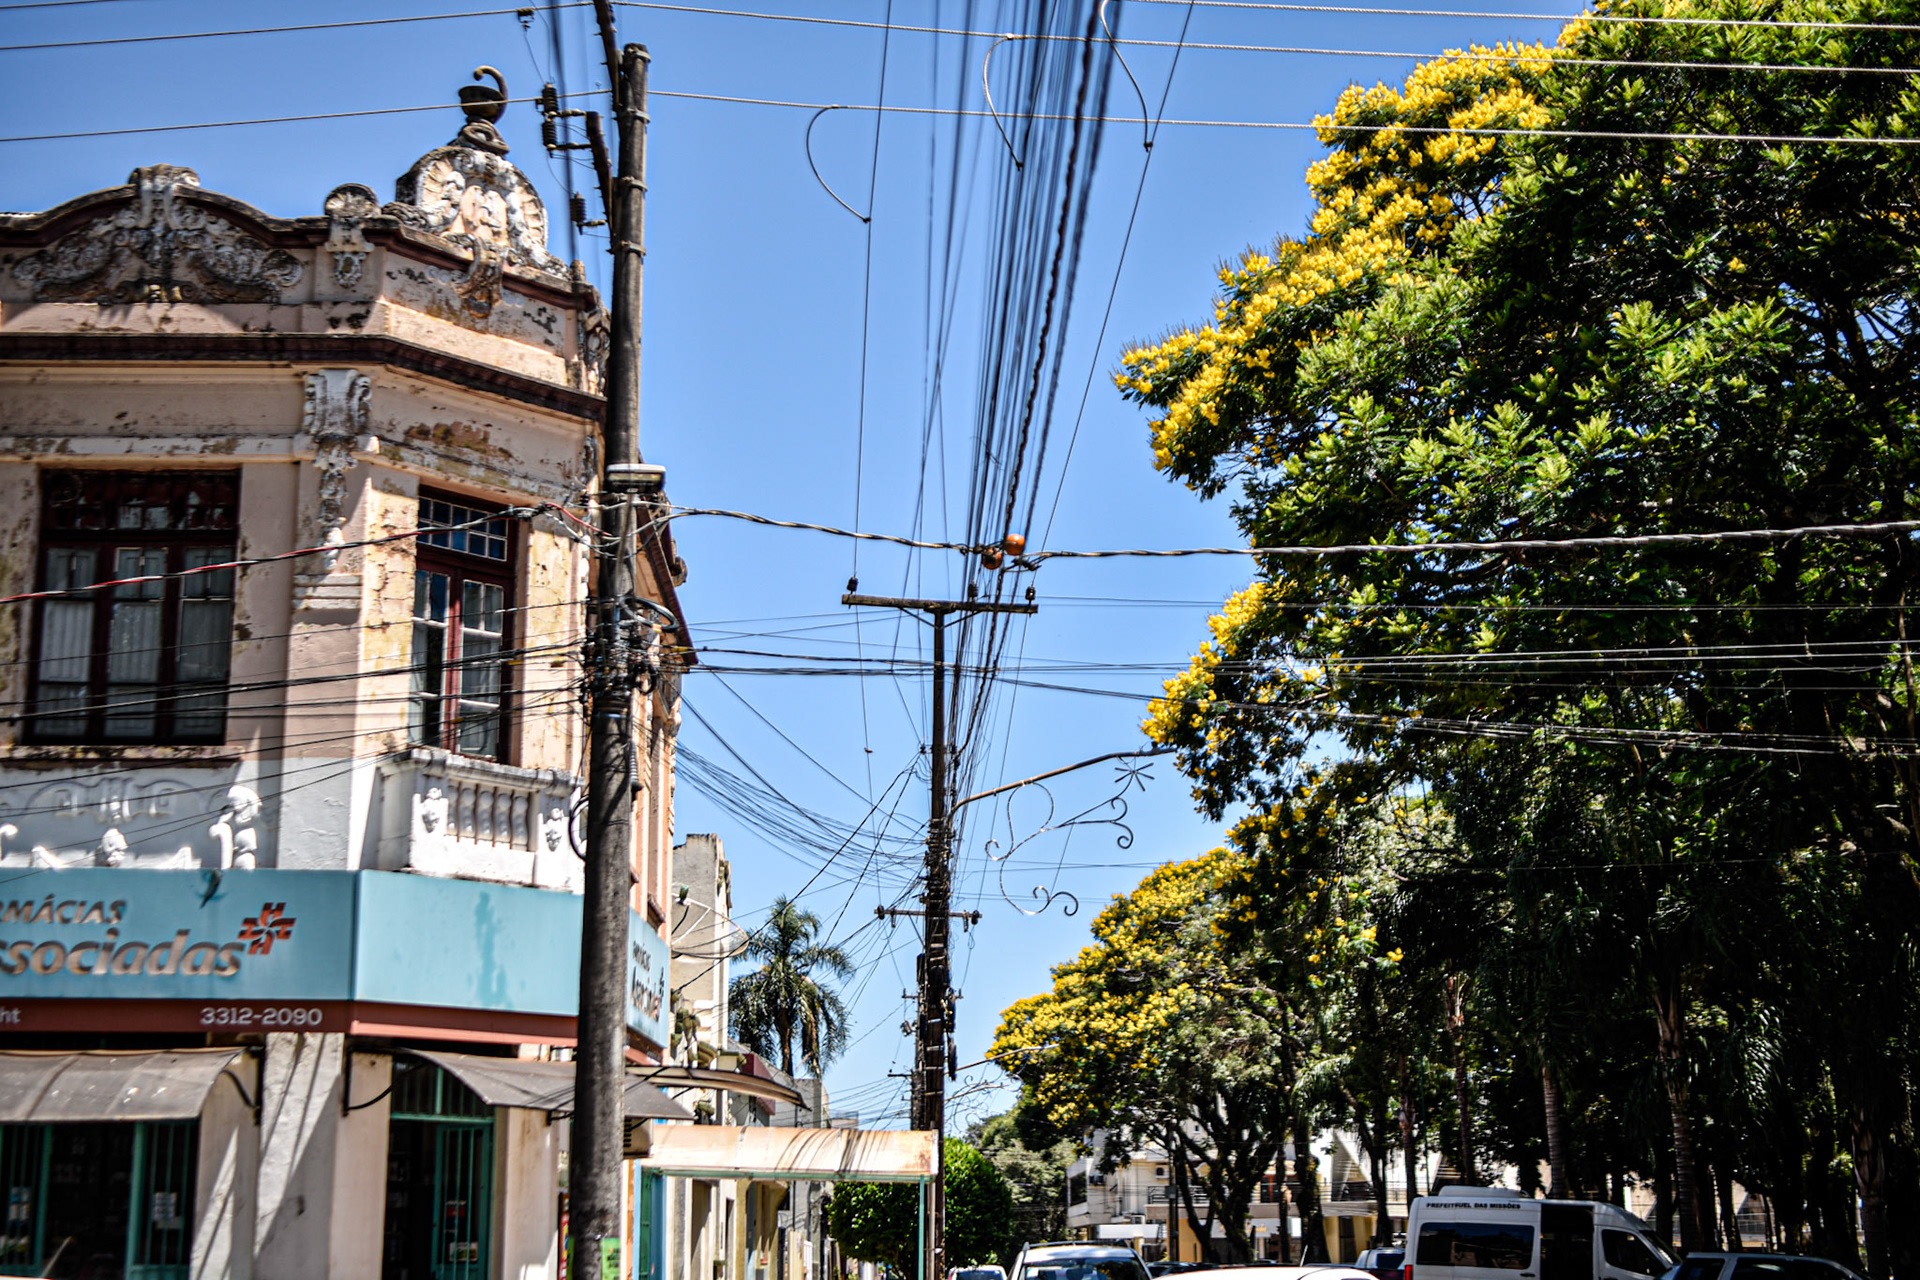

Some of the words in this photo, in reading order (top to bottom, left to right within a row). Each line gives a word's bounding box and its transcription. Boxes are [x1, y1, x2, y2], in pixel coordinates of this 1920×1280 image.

[0, 893, 126, 925] MÁCIAS
[0, 927, 246, 976] sociadas
[201, 1007, 323, 1025] 3312-2090
